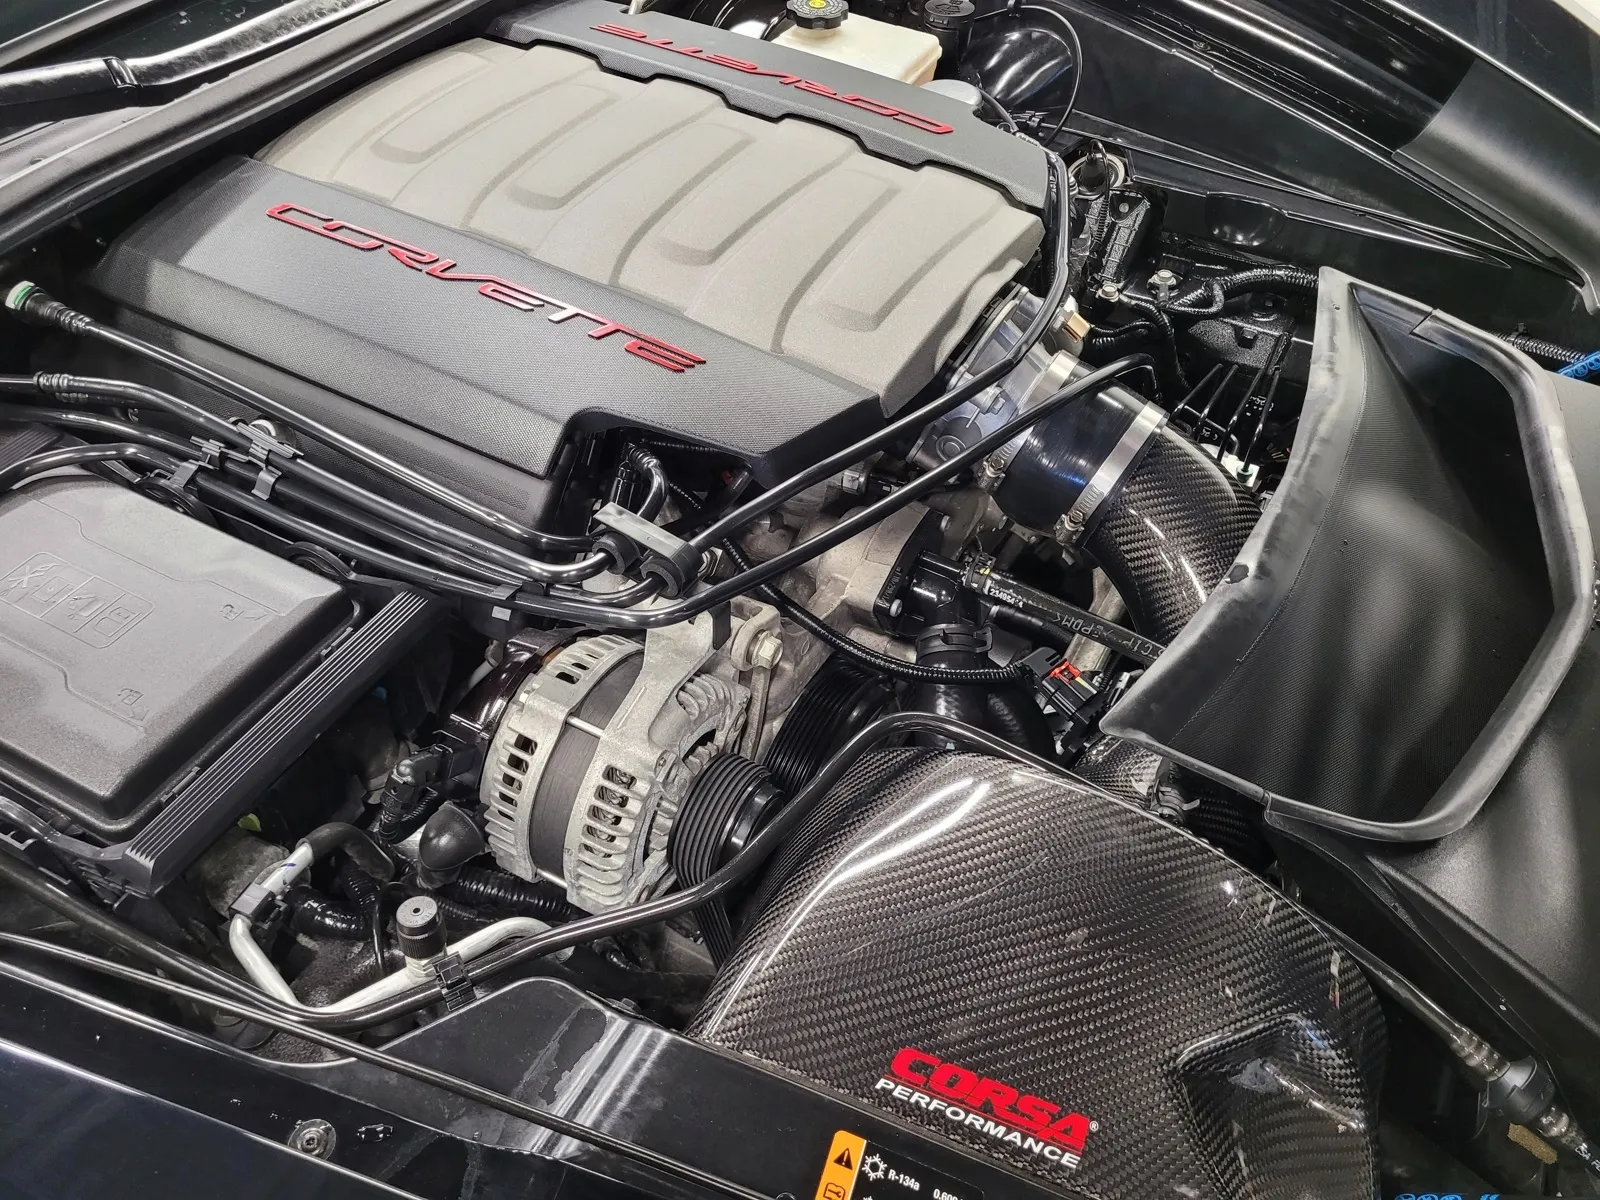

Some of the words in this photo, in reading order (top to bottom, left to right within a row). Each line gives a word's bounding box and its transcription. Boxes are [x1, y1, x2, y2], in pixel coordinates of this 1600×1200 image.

[590, 23, 954, 134] CORVETTE
[265, 203, 706, 373] CORVETTE
[874, 1077, 1081, 1169] PERFORMANCE
[890, 1047, 1091, 1150] CORSA
[888, 1168, 920, 1191] R-134a
